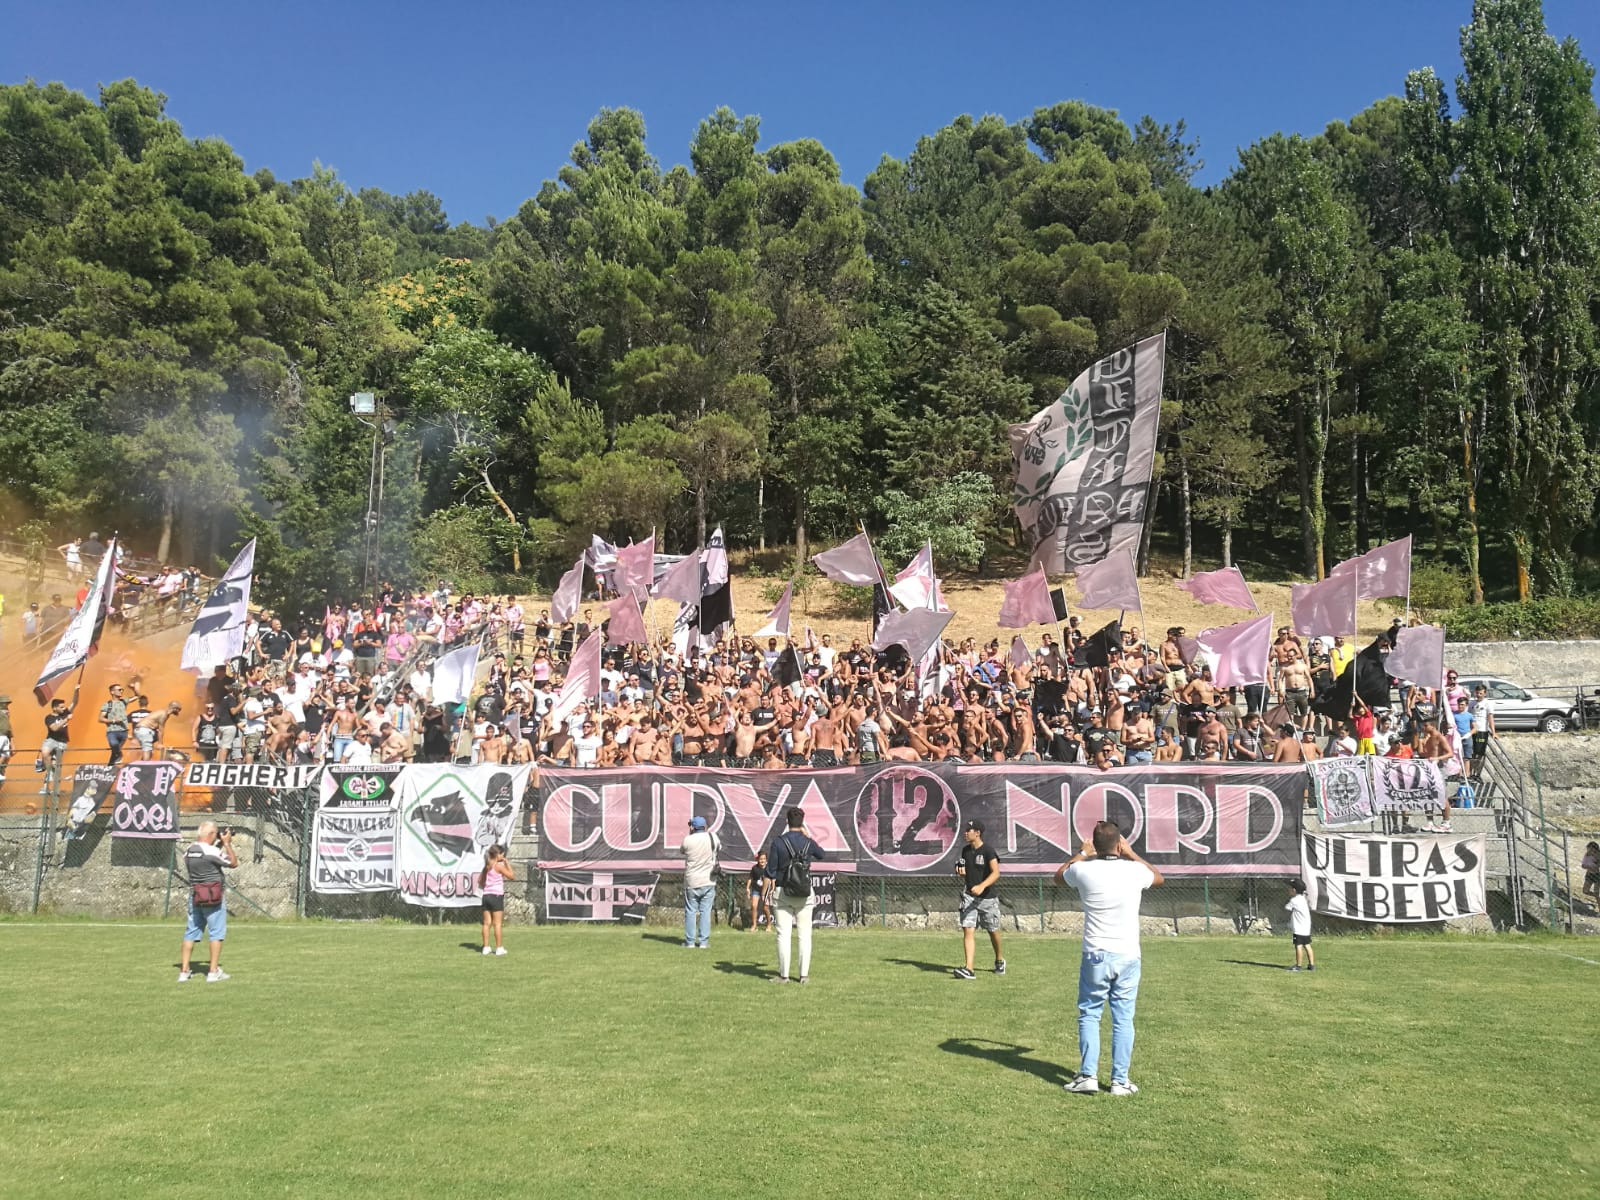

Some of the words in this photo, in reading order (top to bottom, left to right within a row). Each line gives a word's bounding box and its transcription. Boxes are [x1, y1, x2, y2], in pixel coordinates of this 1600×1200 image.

[542, 777, 852, 856] CURVA
[870, 775, 946, 856] 12
[1006, 778, 1285, 857] NORD
[319, 868, 393, 884] BARUNI
[1304, 833, 1478, 877] ULTRAS
[1316, 876, 1472, 920] LIBERI
